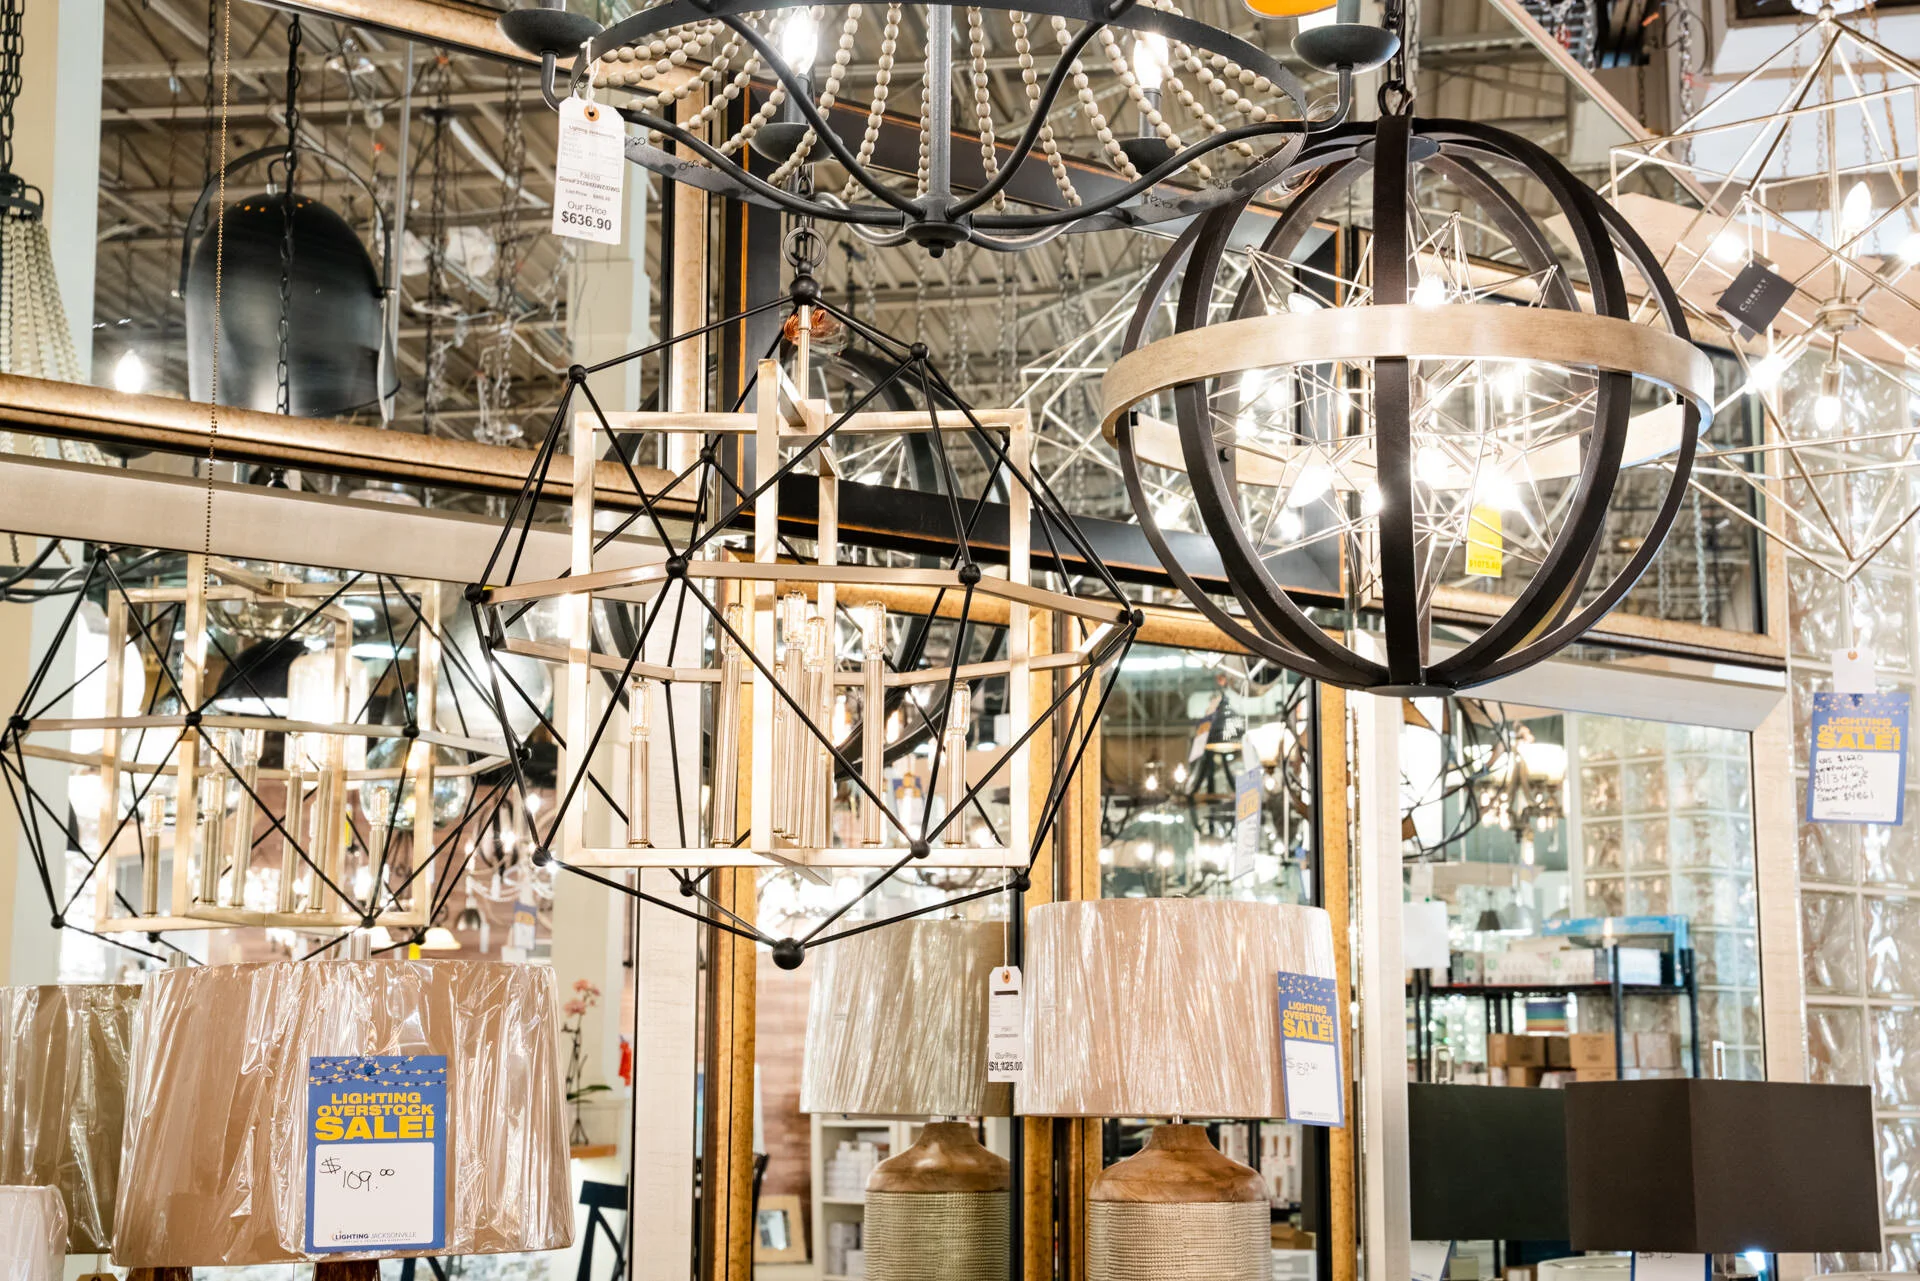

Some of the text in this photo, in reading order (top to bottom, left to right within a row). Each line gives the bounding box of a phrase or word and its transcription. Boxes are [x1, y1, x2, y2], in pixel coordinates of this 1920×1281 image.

[567, 201, 607, 216] Our Price
[561, 210, 612, 231] $636.90
[1827, 717, 1892, 726] LIGHTING
[1818, 725, 1901, 734] OVERSTOCK
[1816, 732, 1901, 751] SALE!
[1288, 1001, 1327, 1015] LIGHTING
[1282, 1010, 1333, 1025] OVERSTOCK
[1282, 1020, 1334, 1043] SALE!
[331, 1092, 421, 1104] LIGHTING
[317, 1104, 434, 1116] OVERSTOCK
[315, 1115, 435, 1141] SALE!
[335, 1231, 369, 1240] LIGHTING
